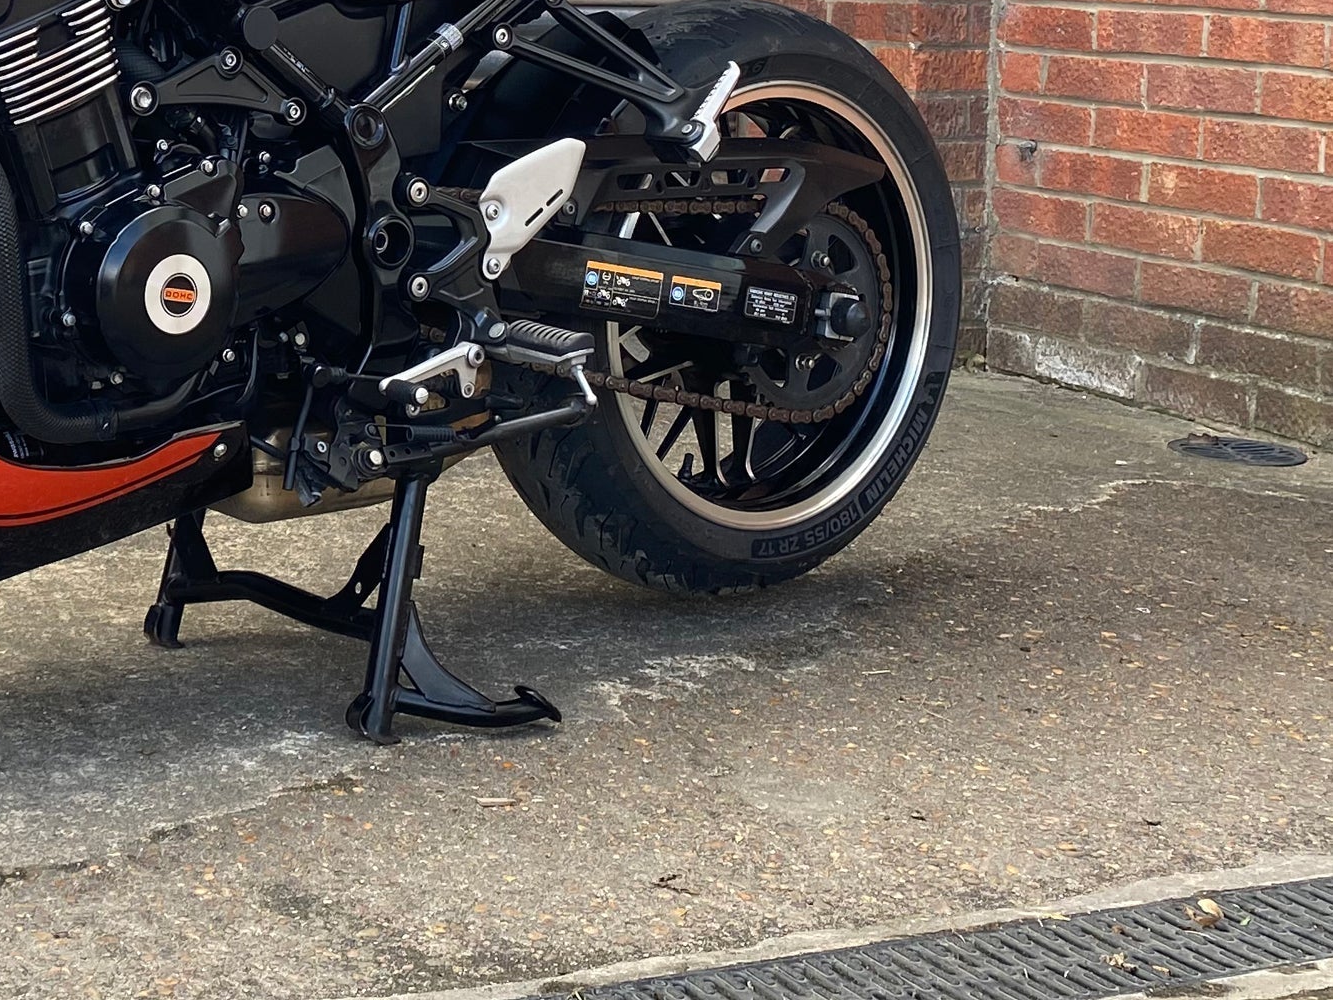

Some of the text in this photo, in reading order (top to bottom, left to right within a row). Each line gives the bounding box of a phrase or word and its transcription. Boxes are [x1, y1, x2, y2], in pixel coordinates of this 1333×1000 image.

[165, 291, 193, 300] DOHC
[758, 410, 928, 556] MICHELIN 180/55 ZR 17
